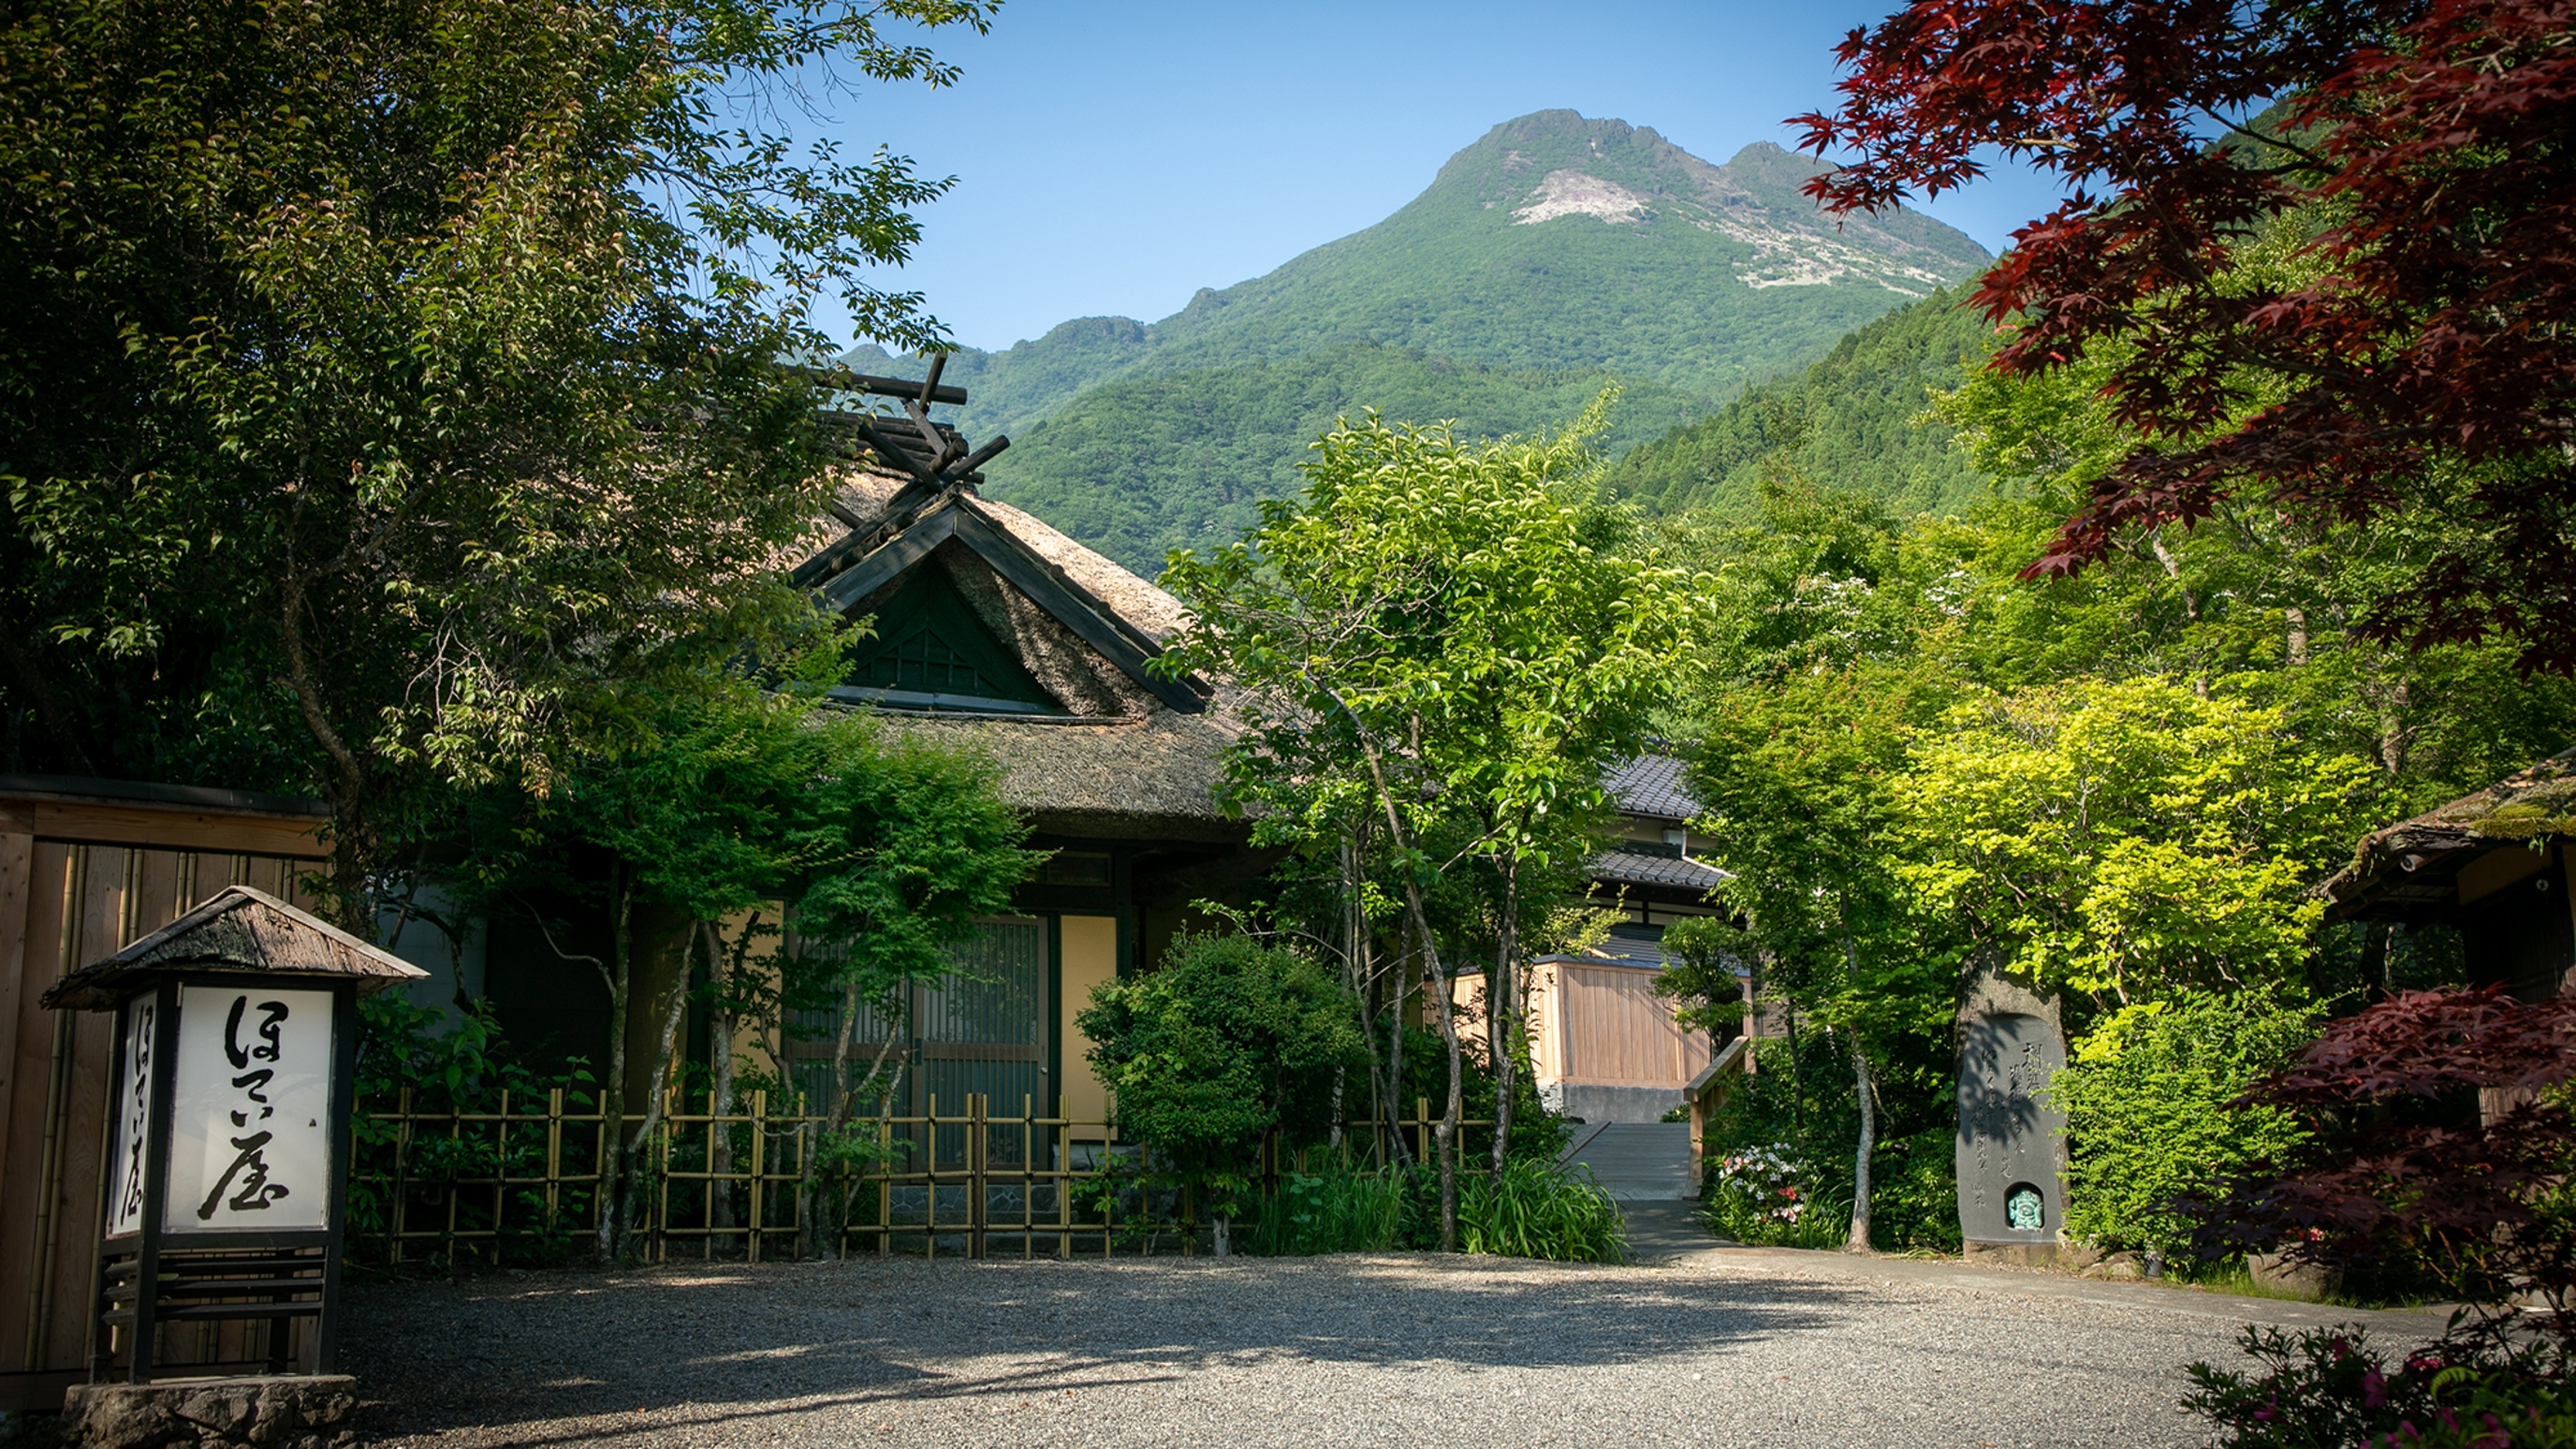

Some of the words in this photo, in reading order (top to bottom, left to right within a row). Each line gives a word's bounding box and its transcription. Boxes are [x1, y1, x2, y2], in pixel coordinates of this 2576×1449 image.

[120, 1004, 154, 1226] ほてい屋
[198, 995, 289, 1221] ほてい屋
